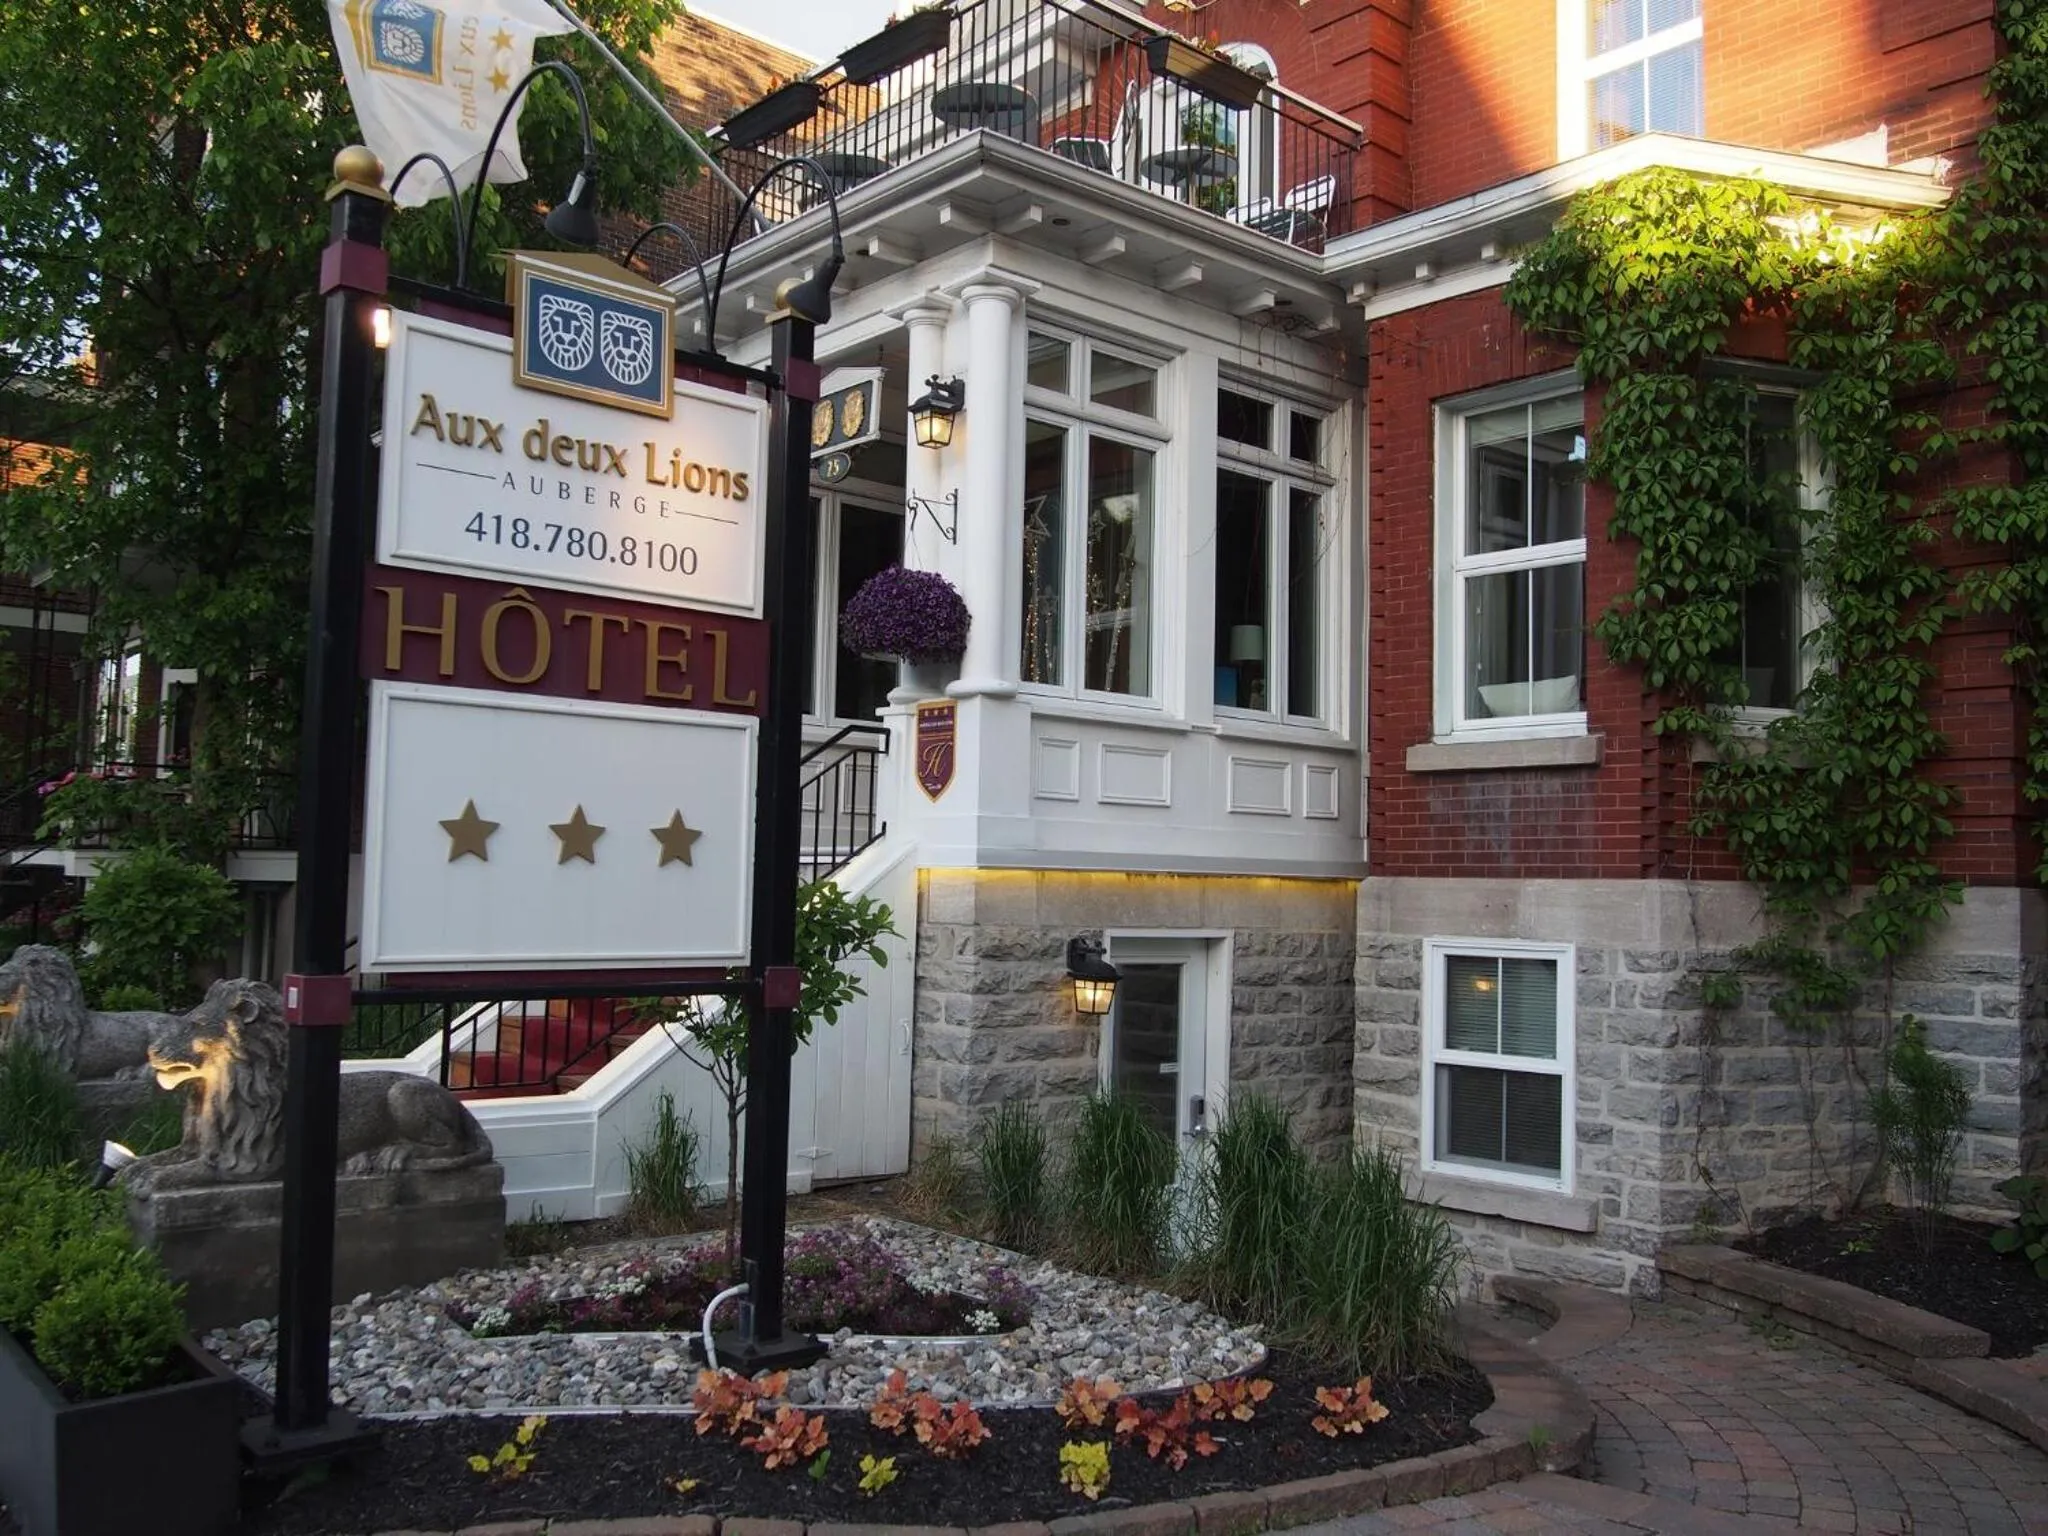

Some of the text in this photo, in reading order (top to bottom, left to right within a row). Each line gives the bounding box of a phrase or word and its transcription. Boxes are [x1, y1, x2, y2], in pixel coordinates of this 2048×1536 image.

[410, 393, 750, 502] Aux deux Lions
[501, 470, 671, 518] AUBERGE
[465, 511, 698, 575] 418.780.8100
[374, 585, 757, 708] HÔTEL
